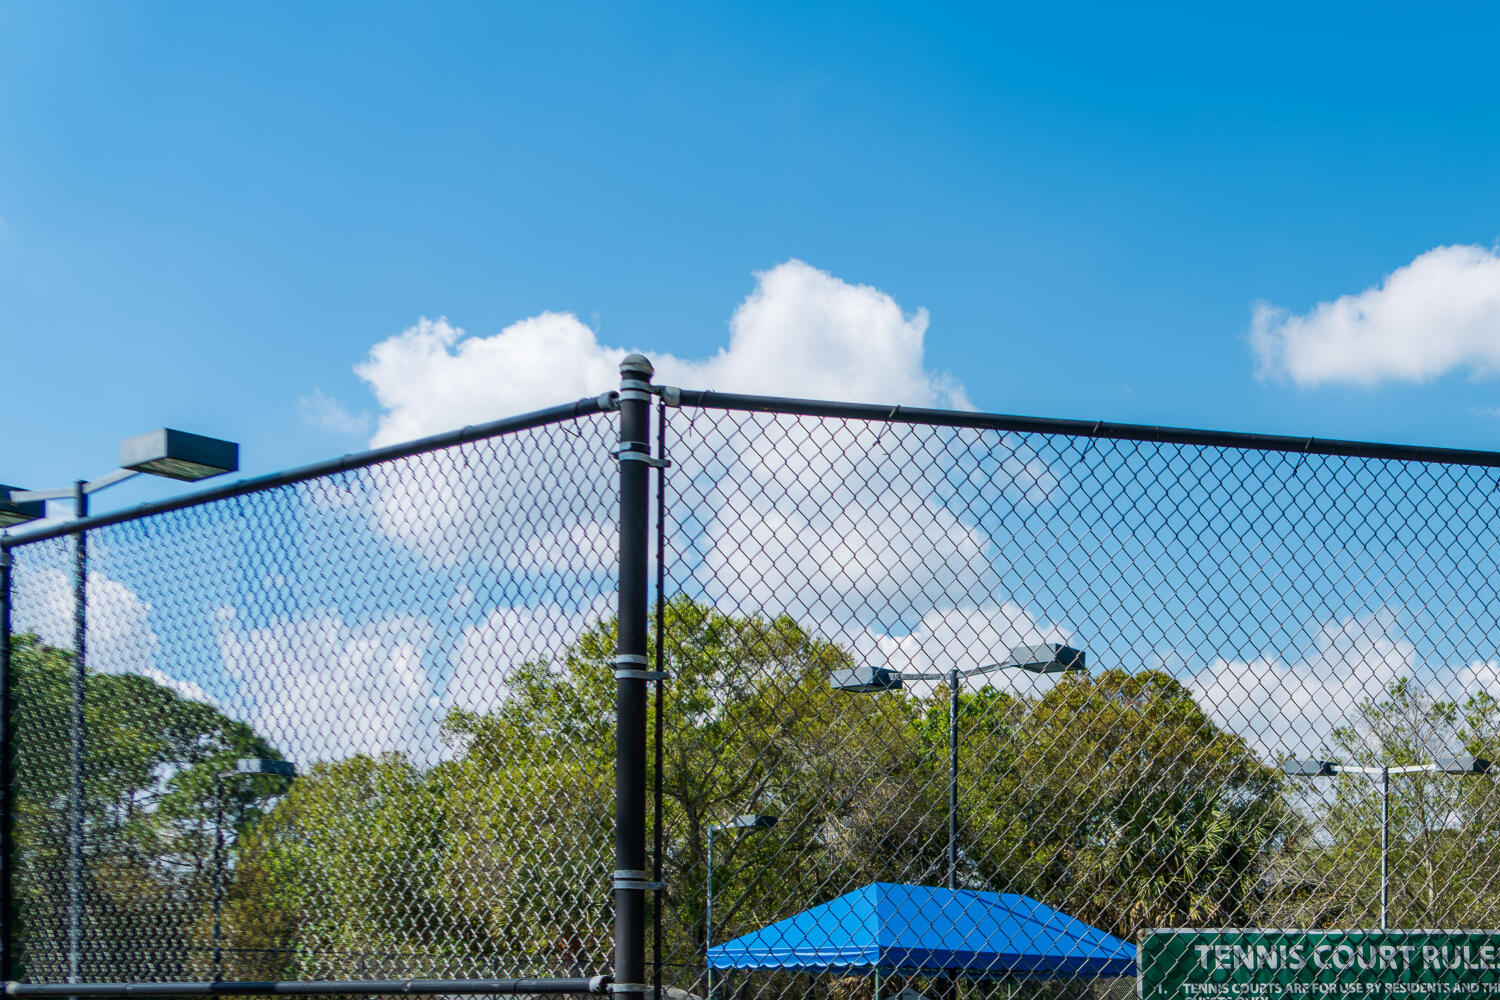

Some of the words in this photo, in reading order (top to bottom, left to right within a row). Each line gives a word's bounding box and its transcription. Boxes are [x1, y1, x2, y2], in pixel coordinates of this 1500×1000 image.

[1194, 945, 1305, 970] TENNIS
[1314, 945, 1415, 970] COURT
[1183, 983, 1229, 994] TENNIS
[1232, 983, 1282, 994] COURTS
[1286, 983, 1309, 993] ARE
[1312, 983, 1337, 993] FOR
[1340, 983, 1363, 993] USE
[1366, 983, 1381, 993] BY
[1385, 983, 1450, 993] RESIDENTS
[1454, 983, 1479, 993] AND
